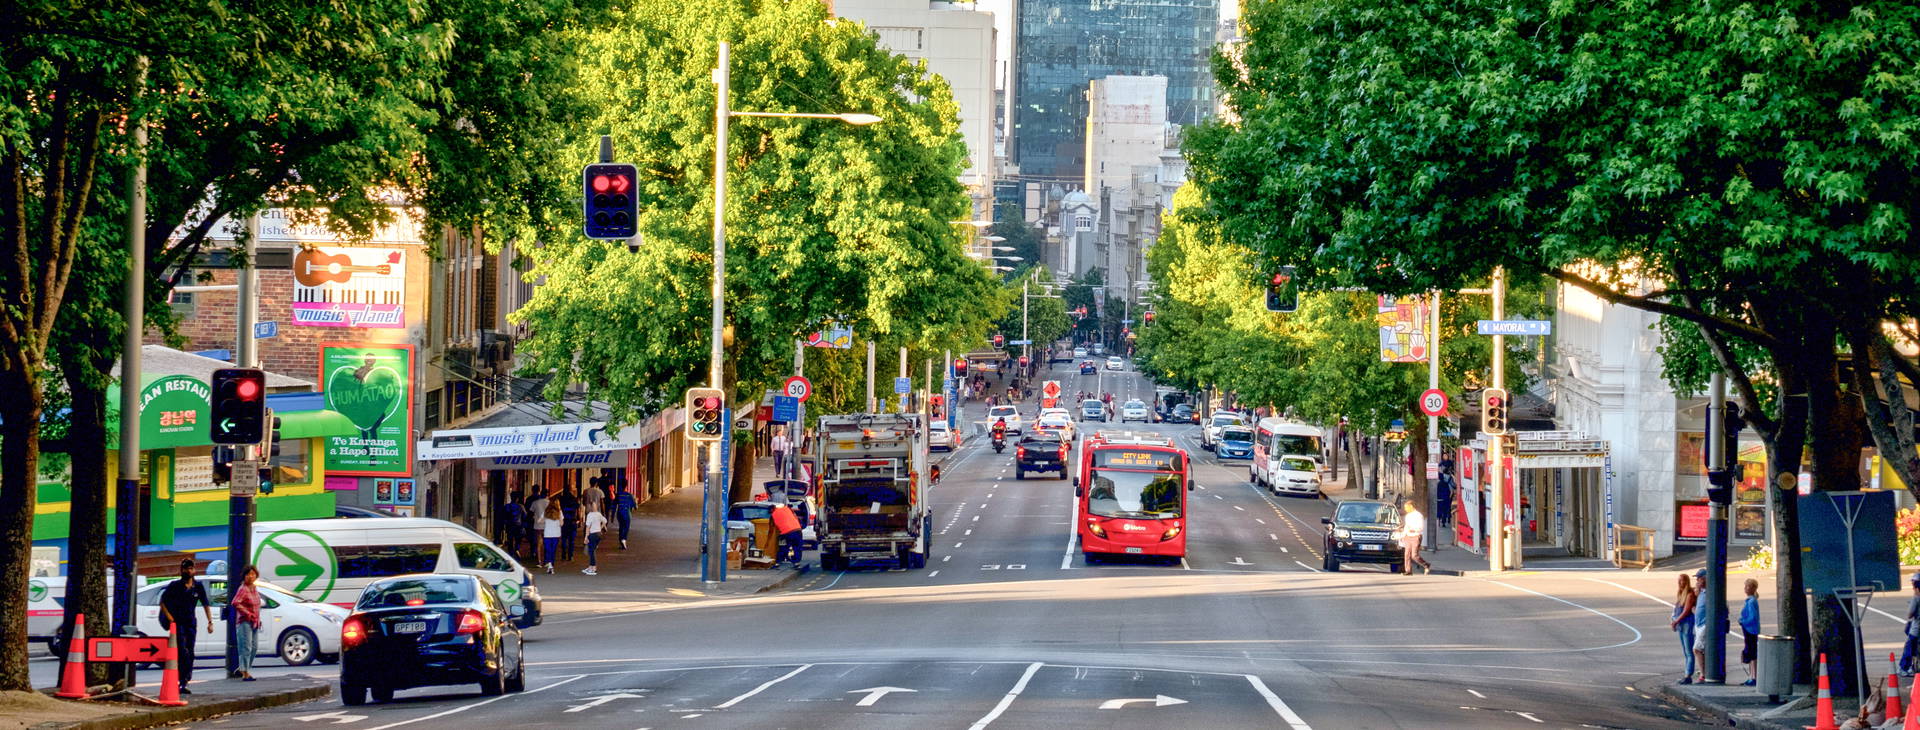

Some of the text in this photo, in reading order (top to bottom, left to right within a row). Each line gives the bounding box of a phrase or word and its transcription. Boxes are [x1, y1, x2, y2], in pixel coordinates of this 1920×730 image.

[295, 304, 402, 326] music planet
[1492, 322, 1527, 333] MAYORAL
[790, 384, 804, 395] 30
[138, 385, 163, 416] EAN
[1426, 397, 1442, 408] 30
[479, 424, 582, 446] music planet
[331, 437, 397, 448] Te Karanga
[339, 447, 368, 457] Hape
[431, 452, 464, 460] Keyboards
[493, 449, 613, 467] music planet
